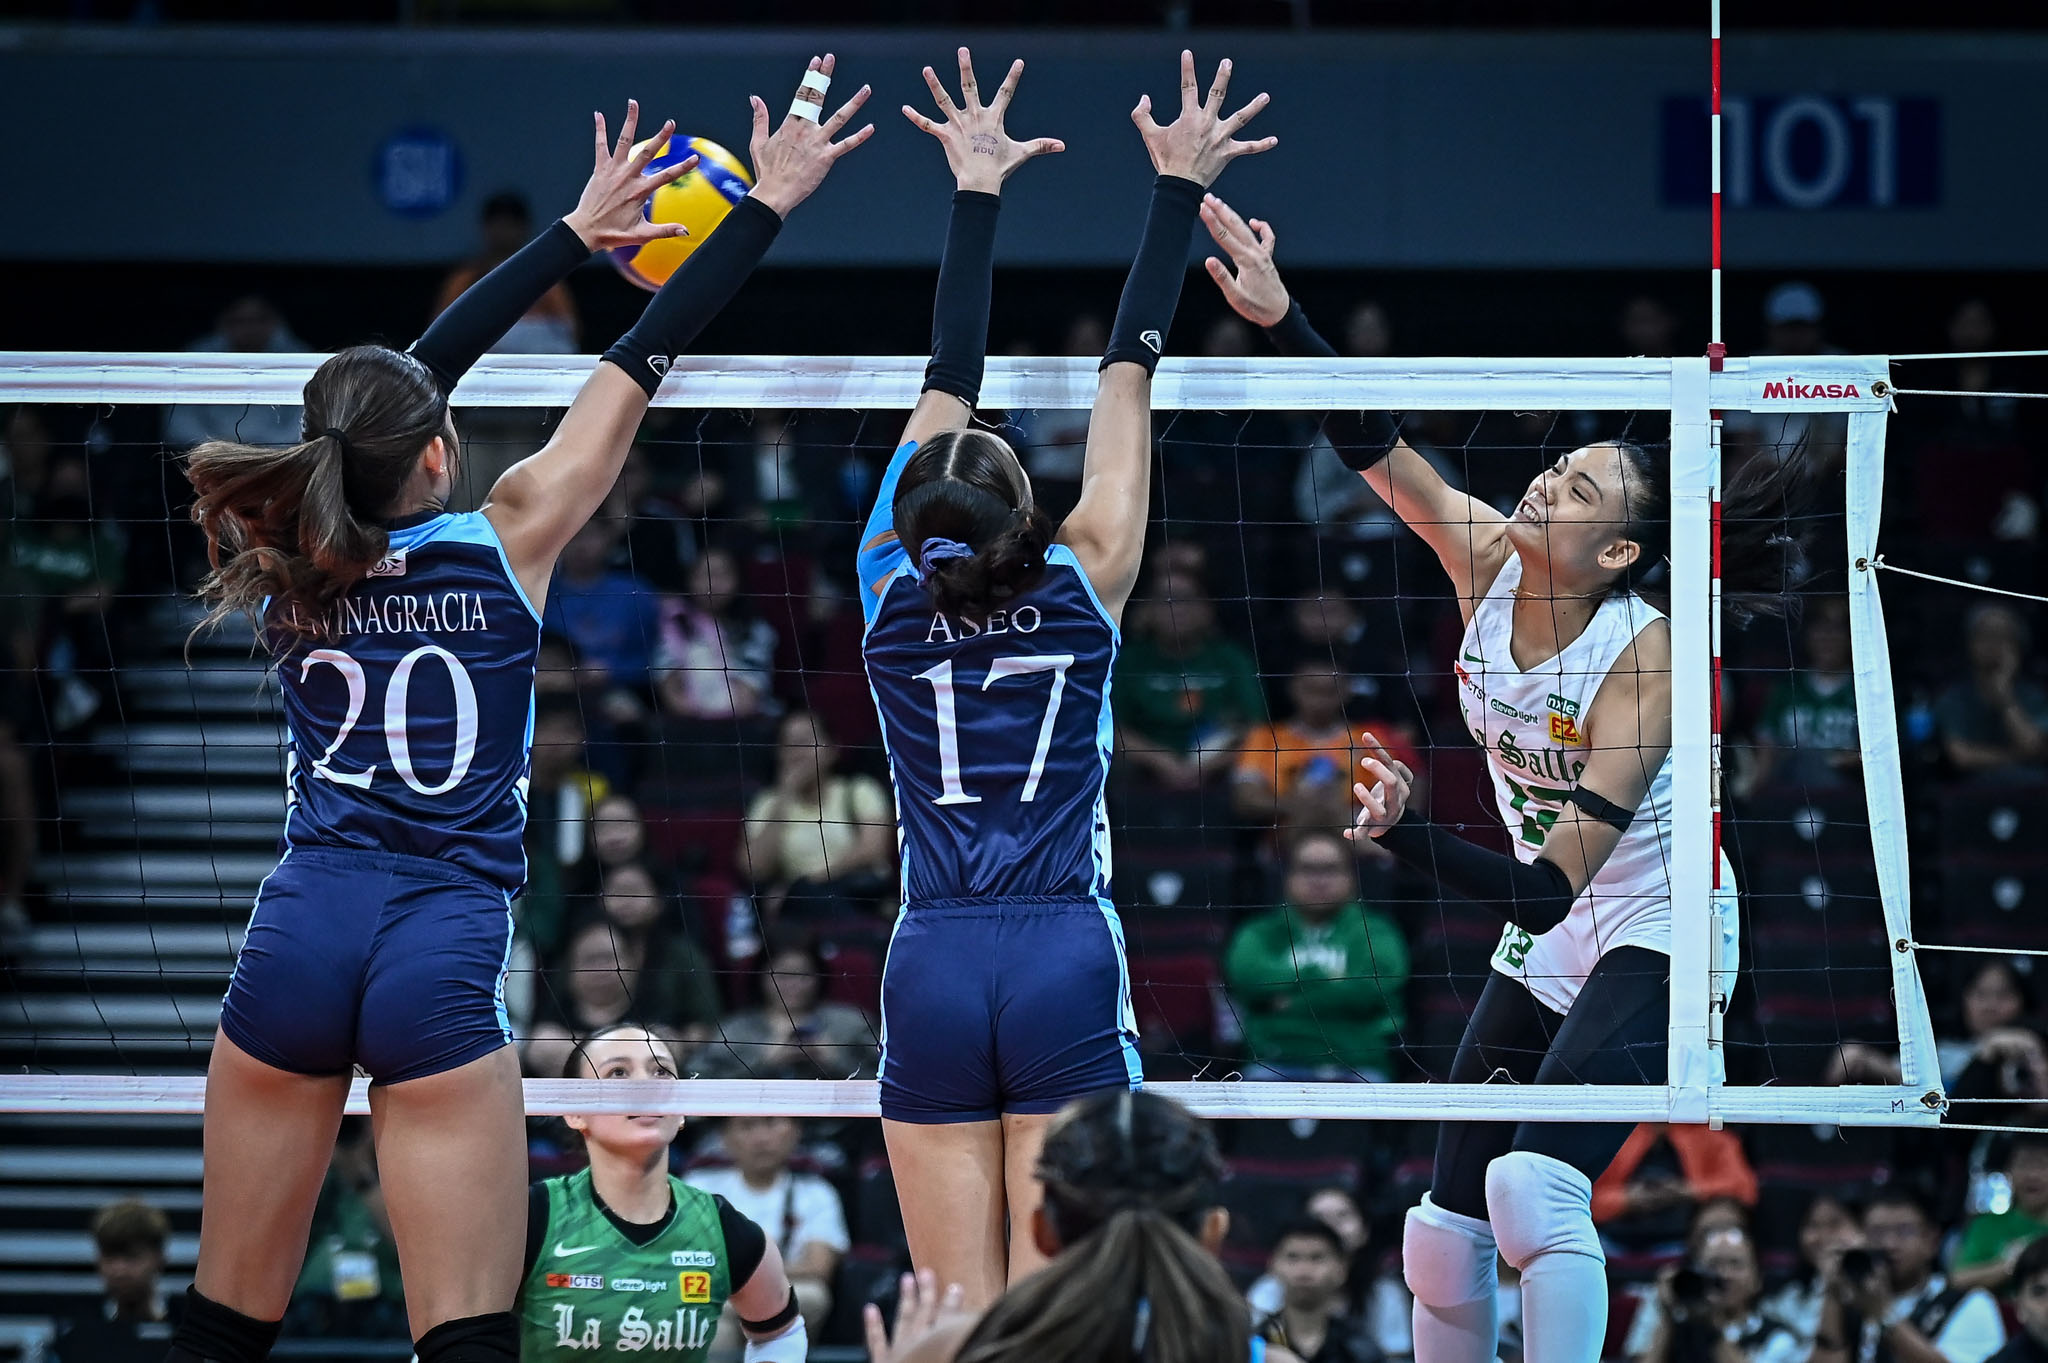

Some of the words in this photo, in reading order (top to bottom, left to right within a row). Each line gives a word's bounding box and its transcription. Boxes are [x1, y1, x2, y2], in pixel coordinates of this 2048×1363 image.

[1718, 98, 1892, 206] 101
[925, 605, 1042, 643] ASEO
[300, 644, 479, 795] 20
[1491, 701, 1516, 717] clever
[1518, 711, 1539, 724] light
[911, 654, 1075, 805] 17
[1891, 1099, 1904, 1113] M
[674, 1254, 713, 1265] nxled
[570, 1276, 603, 1288] ICTSI
[614, 1280, 643, 1290] clever
[645, 1281, 667, 1292] light
[684, 1275, 707, 1294] F2
[552, 1303, 602, 1350] La
[616, 1305, 710, 1352] Salle
